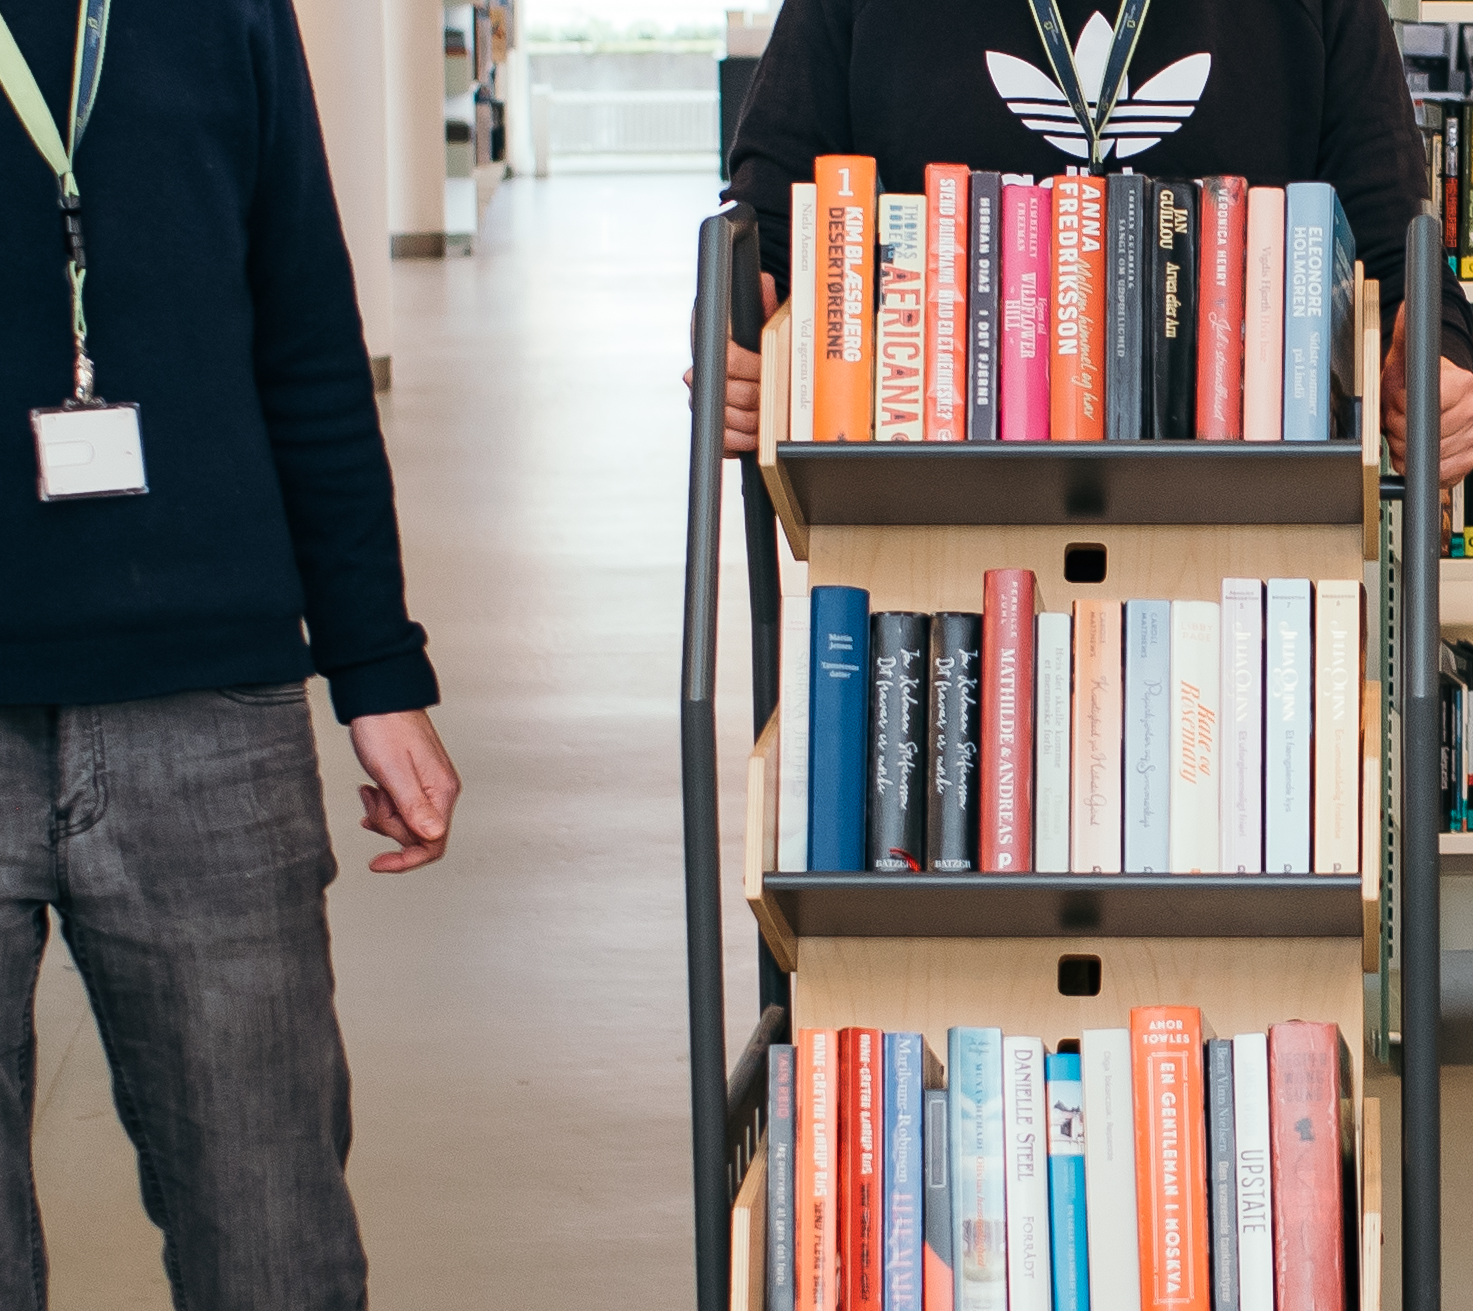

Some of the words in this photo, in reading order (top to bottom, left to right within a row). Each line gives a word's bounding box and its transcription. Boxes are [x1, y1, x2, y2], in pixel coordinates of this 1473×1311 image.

[838, 168, 854, 197] 1
[939, 178, 955, 216] SVEND
[845, 206, 863, 241] KIM
[904, 204, 919, 260] THOMAS
[978, 197, 990, 254] HERNAN
[1017, 202, 1026, 252] FREEMAN
[1029, 197, 1038, 259] KIMBERLEY
[1081, 184, 1101, 252] ANNA
[1159, 189, 1173, 249] GUILLOU
[1174, 209, 1188, 234] JAN
[1217, 189, 1228, 245] VERONICA
[938, 218, 955, 283] BRINKMANN
[977, 259, 990, 293] DIAZ
[1057, 183, 1079, 355] FREDRIKSSON
[1215, 250, 1227, 287] HENRY
[1292, 226, 1307, 317] HOLMGREN
[1307, 227, 1323, 317] ELEONORE
[826, 207, 845, 360] DESERTØRERNE
[844, 245, 863, 362] BLÆSBJERG
[937, 289, 954, 318] HVAD
[1075, 257, 1093, 313] Mellem
[1165, 262, 1179, 294] Arven
[937, 320, 954, 335] ER
[1004, 299, 1021, 332] HILL
[1020, 272, 1036, 359] WILDFLOWER
[1165, 294, 1181, 317] efter
[1165, 317, 1179, 338] Arn
[881, 264, 921, 427] AFRICANA
[937, 337, 954, 352] ET
[977, 321, 990, 348] DET
[1079, 315, 1097, 369] himmel
[1292, 348, 1305, 363] på
[1308, 331, 1320, 365] Sidste
[936, 353, 955, 420] MENNESKE?
[977, 353, 989, 406] FJERNE
[1071, 372, 1093, 389] og
[1308, 369, 1319, 417] sommer
[1081, 391, 1097, 421] hav
[900, 675, 919, 735] Kalman
[958, 675, 977, 735] Kalman
[999, 647, 1015, 745] MATHILDE
[1000, 747, 1011, 757] &
[1179, 680, 1200, 785] Rosemary
[1198, 704, 1216, 752] Kate
[1199, 756, 1213, 776] og
[998, 759, 1014, 845] ANDREAS
[1143, 1034, 1190, 1044] TOWLES
[1149, 1020, 1183, 1030] AMOR
[1159, 1062, 1173, 1084] EN
[1216, 1047, 1228, 1073] Bent
[1013, 1049, 1034, 1125] DANIELLE
[896, 1114, 912, 1183] Robinson
[1162, 1092, 1178, 1196] GENTLEMAN
[1218, 1107, 1229, 1153] Nielsen
[1017, 1133, 1035, 1182] STEEL
[1240, 1149, 1267, 1234] UPSTATE
[1022, 1216, 1036, 1278] FORRÅDT
[1165, 1218, 1182, 1293] MOSKVA
